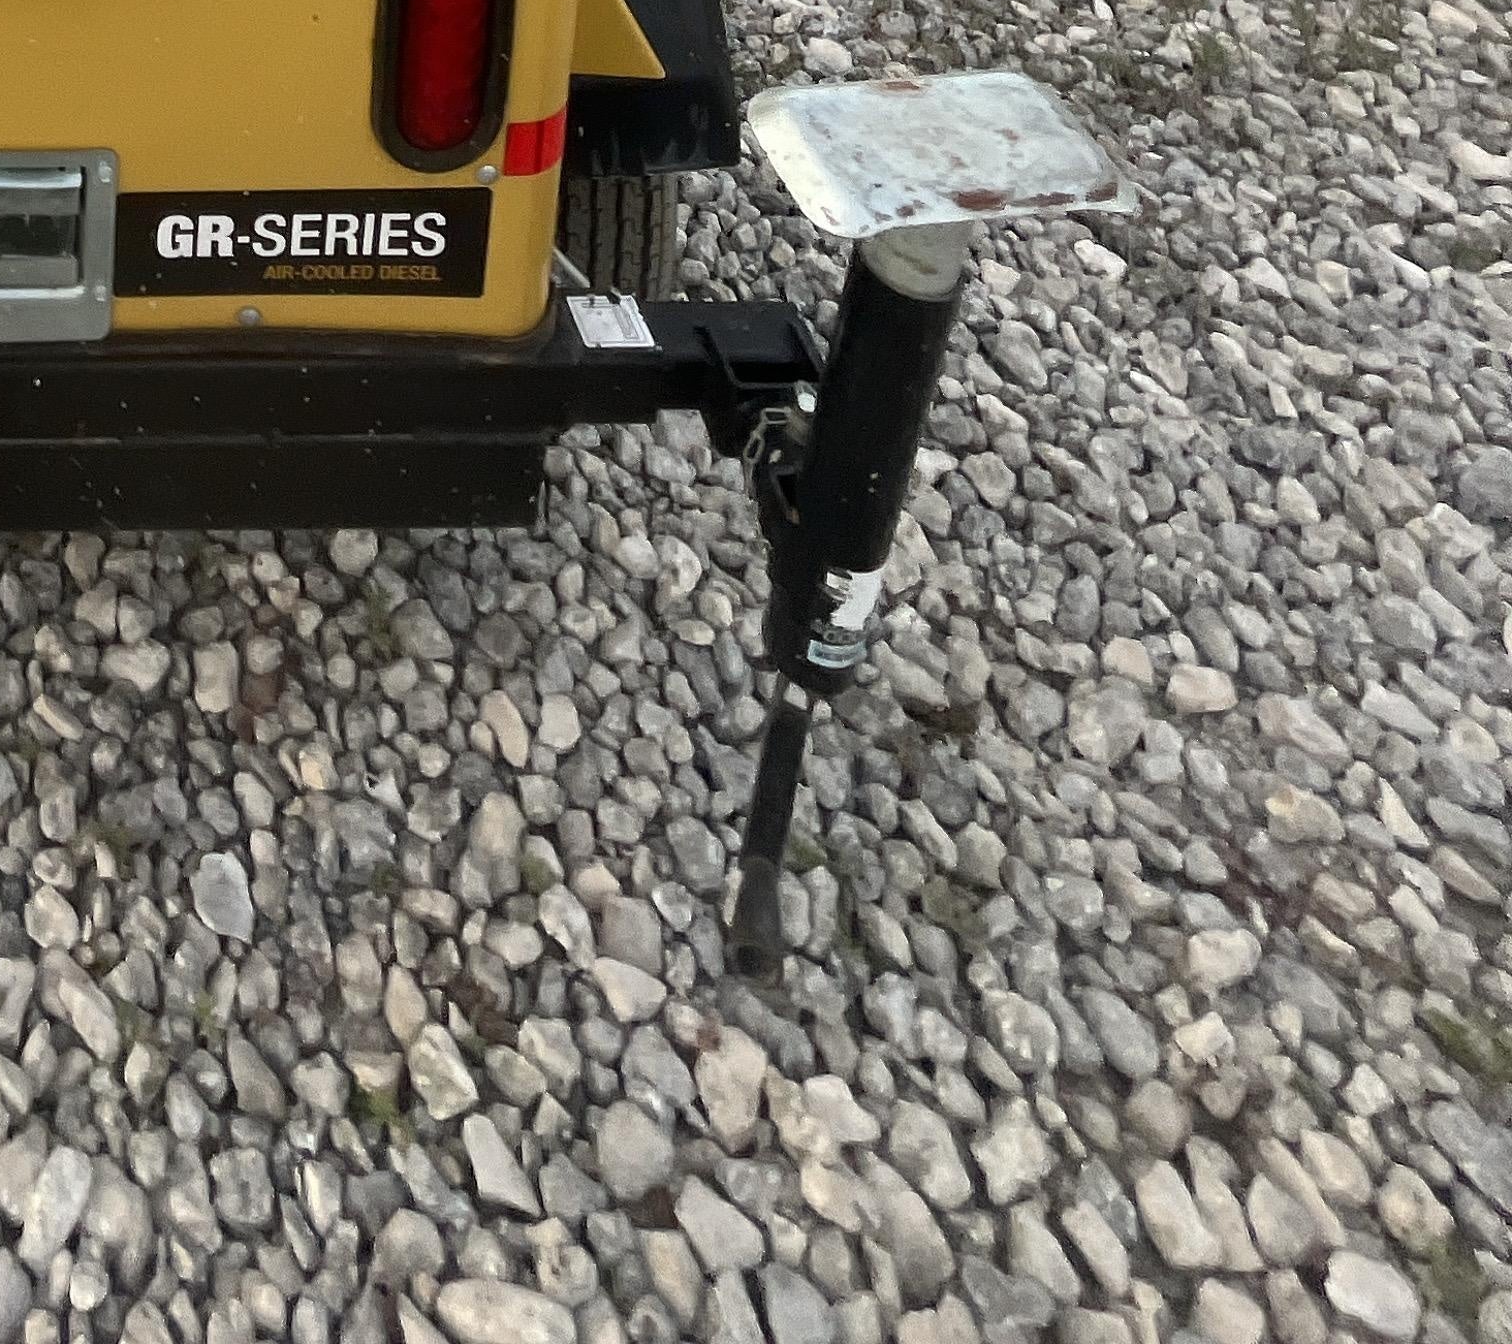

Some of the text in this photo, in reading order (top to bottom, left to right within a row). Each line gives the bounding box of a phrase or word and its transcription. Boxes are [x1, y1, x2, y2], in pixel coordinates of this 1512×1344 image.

[156, 212, 448, 259] GR-SERIES
[263, 264, 441, 281] AIR-COOLED DIESEL
